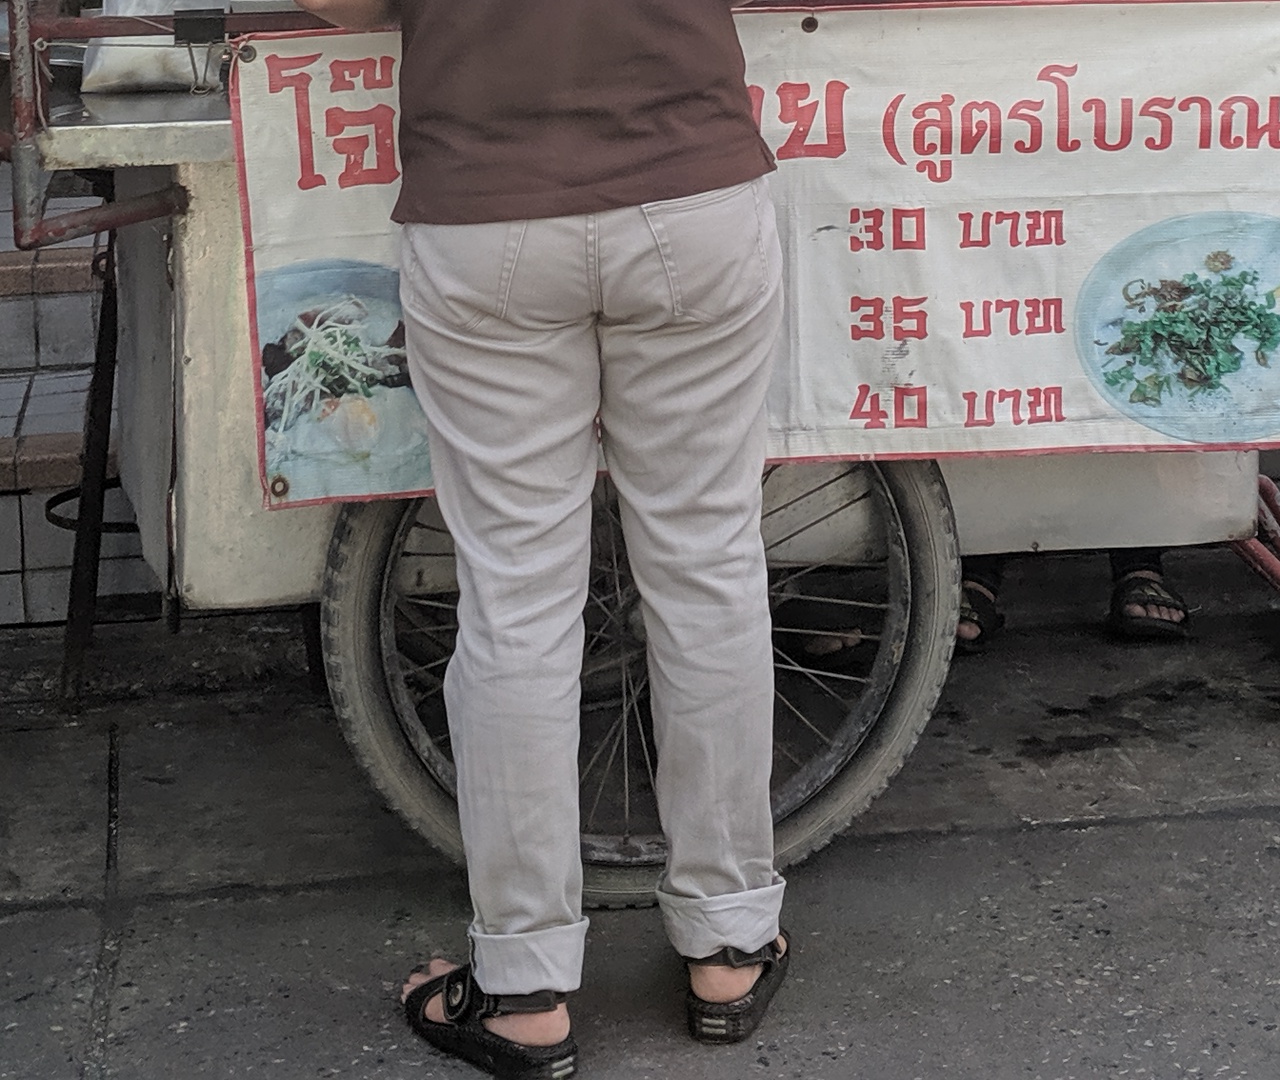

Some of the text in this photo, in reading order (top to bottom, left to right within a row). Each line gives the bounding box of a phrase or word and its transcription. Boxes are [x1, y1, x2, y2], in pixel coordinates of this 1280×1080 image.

[265, 52, 401, 190] โจ๊
[849, 207, 1067, 252] 30 บาท
[850, 296, 1066, 341] 35 บาท
[849, 384, 1067, 429] 40 บาท
